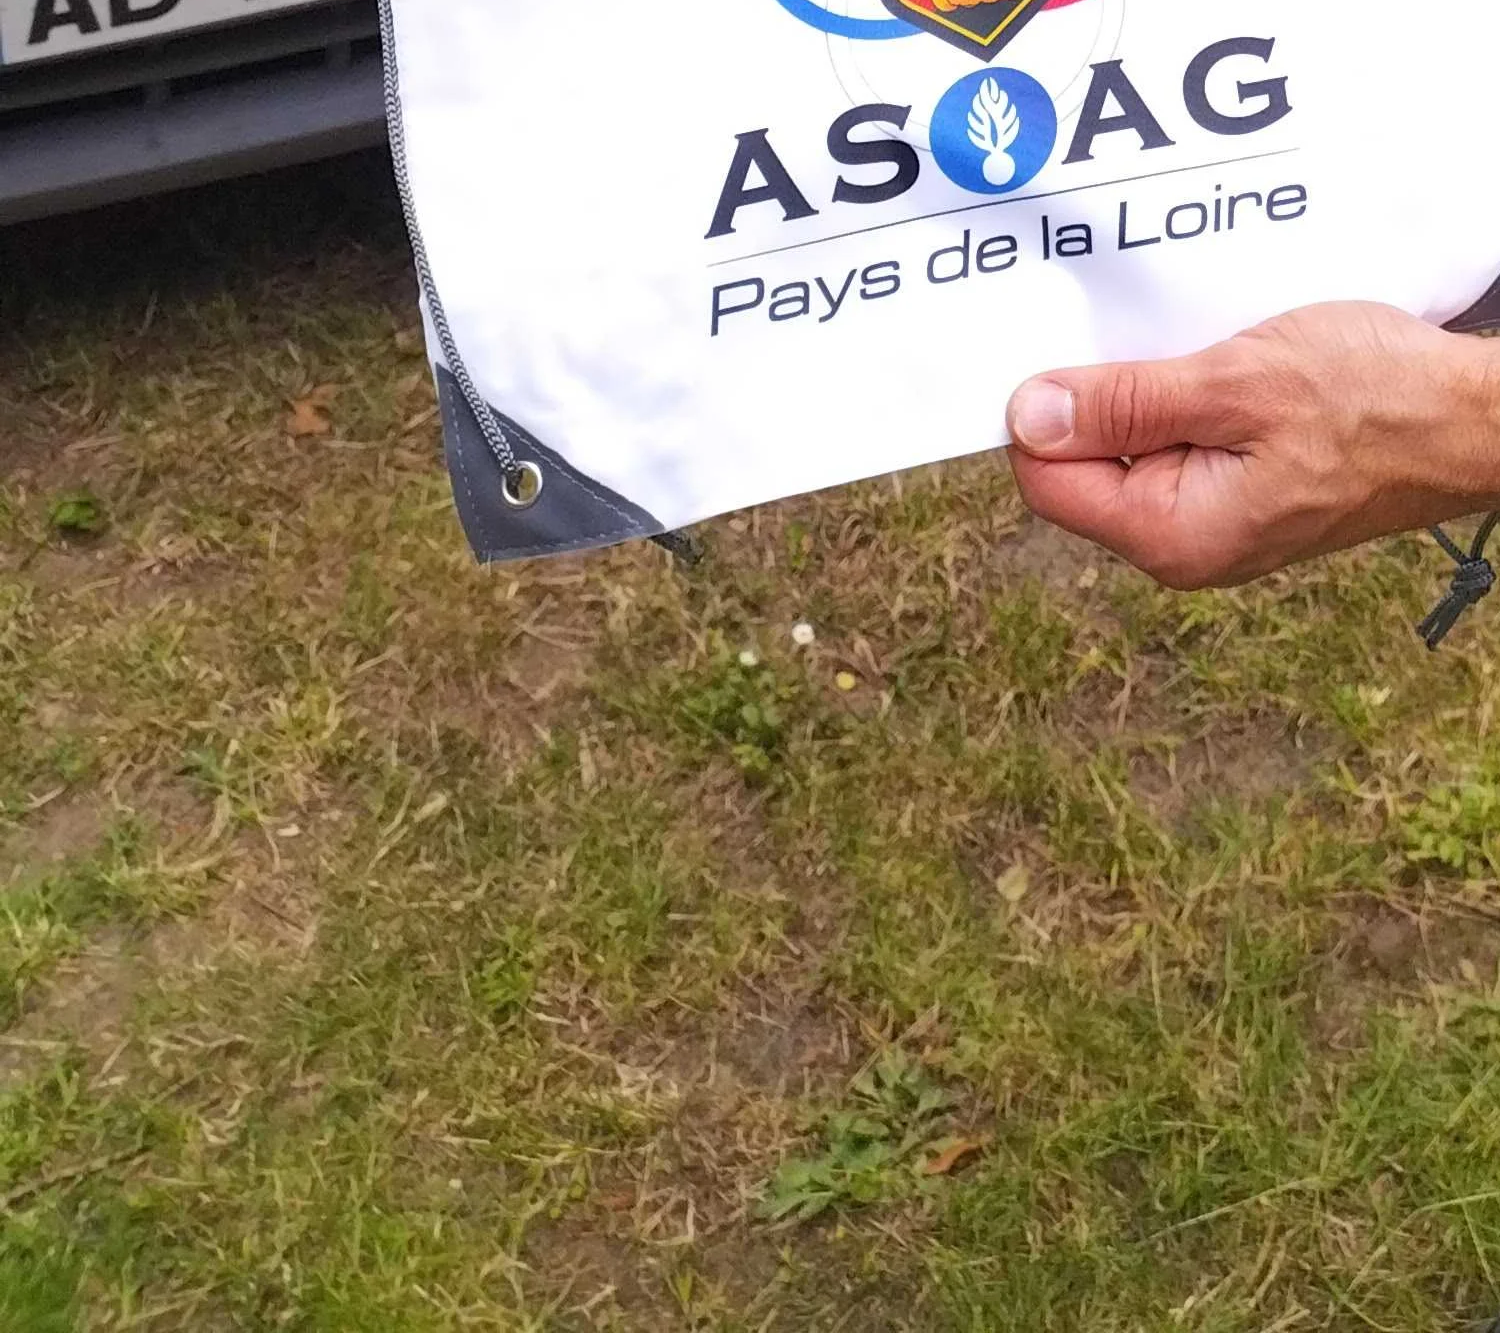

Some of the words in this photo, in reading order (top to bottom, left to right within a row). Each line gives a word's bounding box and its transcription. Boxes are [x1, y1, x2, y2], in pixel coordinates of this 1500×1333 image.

[709, 259, 901, 338] Pays
[925, 228, 1018, 285] de
[1042, 214, 1093, 261] la
[1117, 182, 1309, 251] Loire
